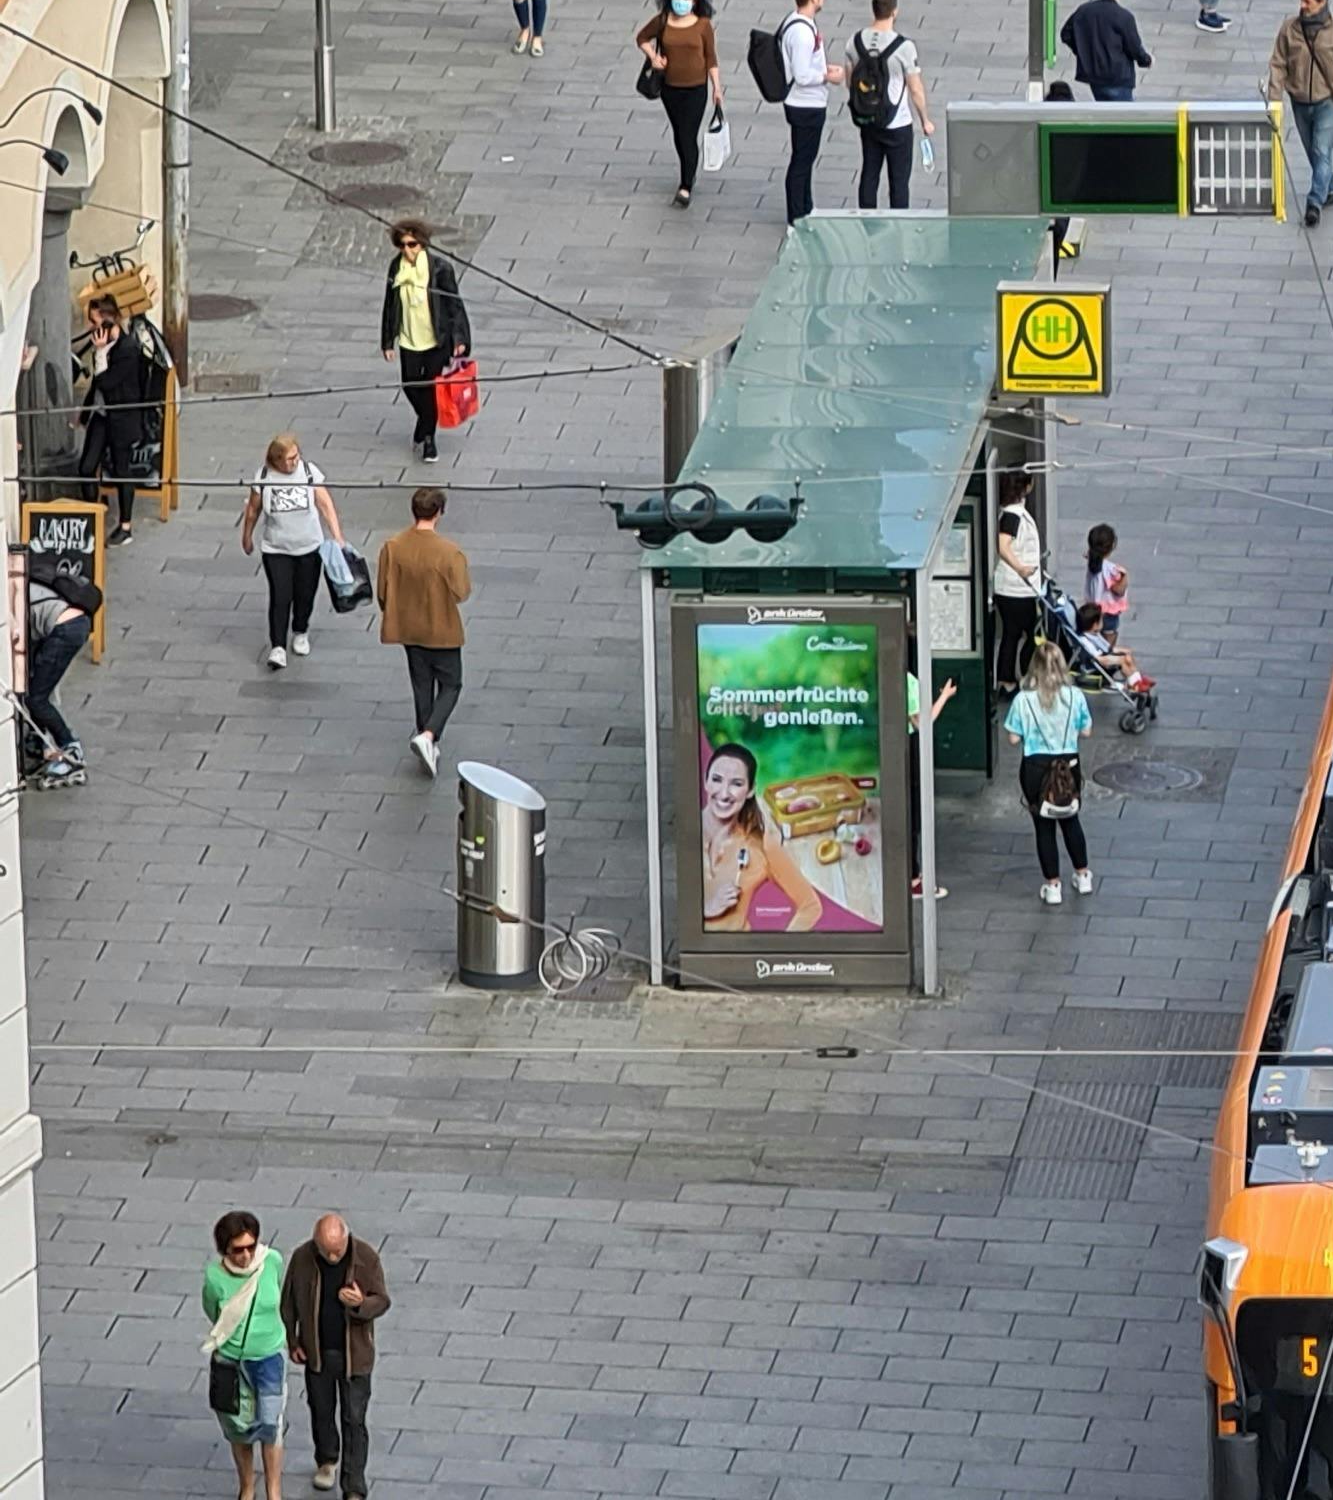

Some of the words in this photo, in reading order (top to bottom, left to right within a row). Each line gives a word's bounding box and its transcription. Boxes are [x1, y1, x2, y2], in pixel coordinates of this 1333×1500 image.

[1032, 316, 1062, 343] HH
[709, 686, 869, 703] Sommerfrüchte
[763, 708, 864, 728] genießen.
[1303, 1337, 1319, 1377] 5
